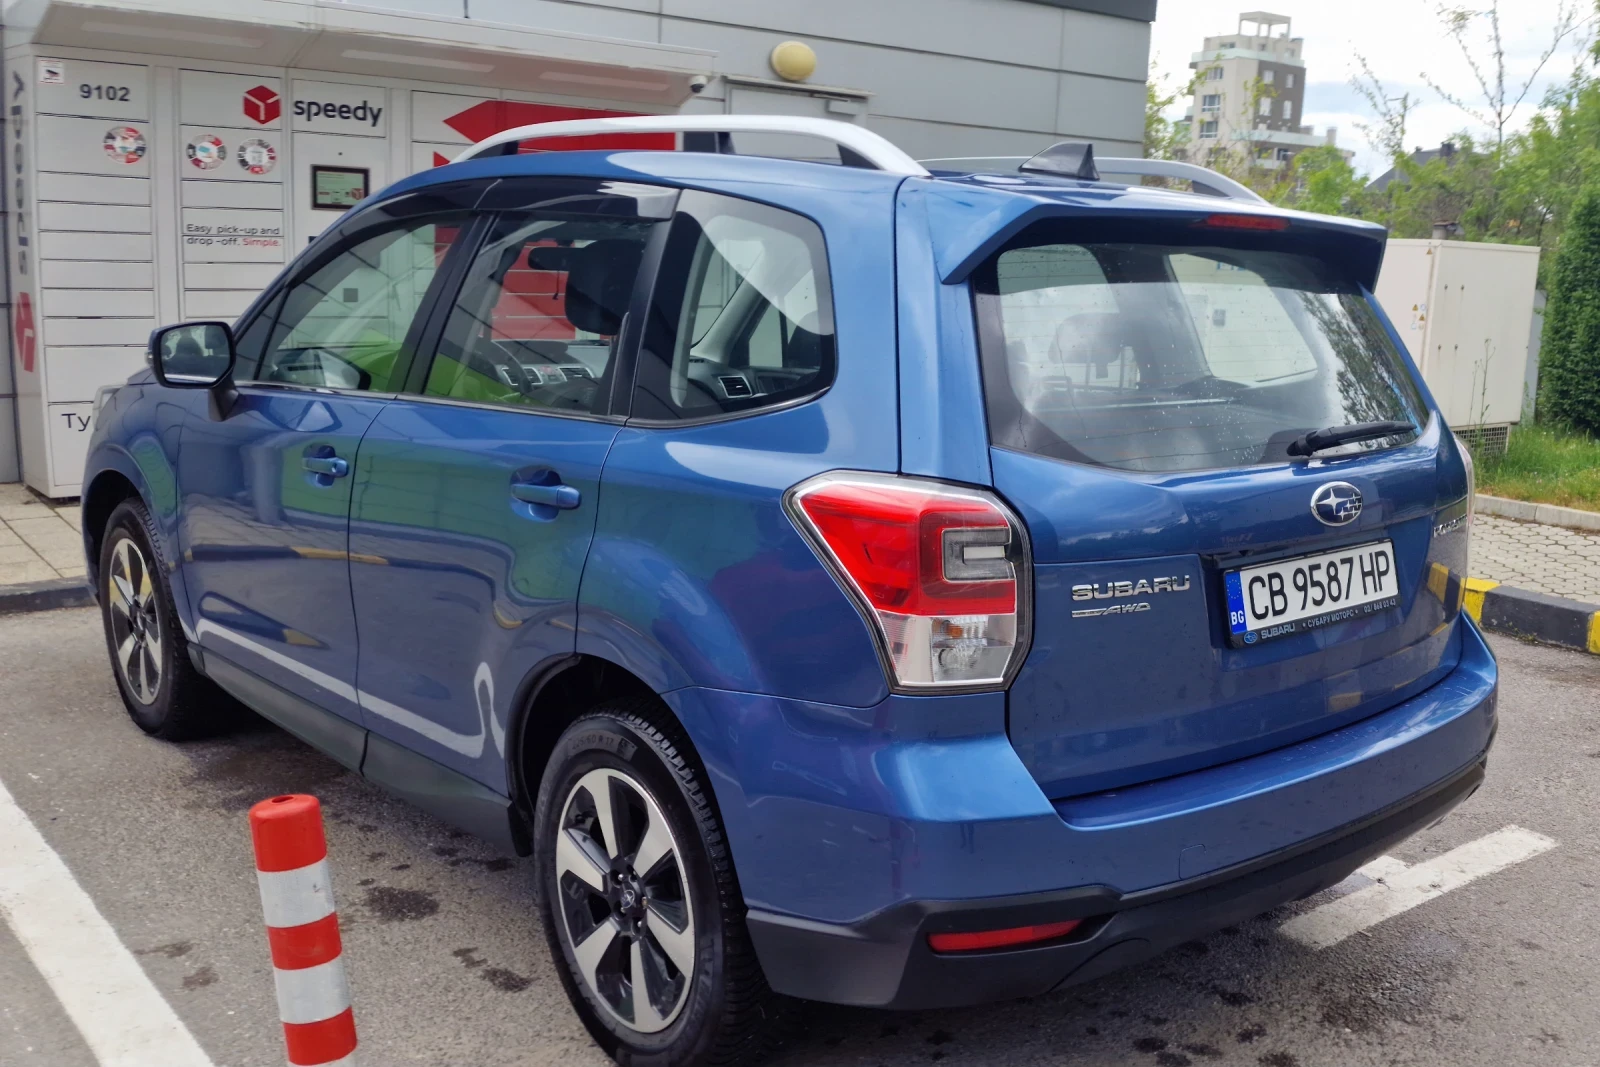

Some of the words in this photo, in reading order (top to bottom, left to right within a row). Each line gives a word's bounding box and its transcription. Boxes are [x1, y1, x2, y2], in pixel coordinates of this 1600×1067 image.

[79, 83, 131, 102] 9102
[293, 99, 383, 128] speedy
[186, 223, 212, 235] Easy
[217, 225, 258, 235] pick-up
[260, 226, 280, 235] and
[242, 237, 281, 247] Simple.
[1071, 574, 1190, 601] SUBARU
[1292, 556, 1354, 611] 9587
[1102, 602, 1151, 616] AWD
[1230, 610, 1245, 626] BG
[1260, 623, 1296, 640] SUBARU
